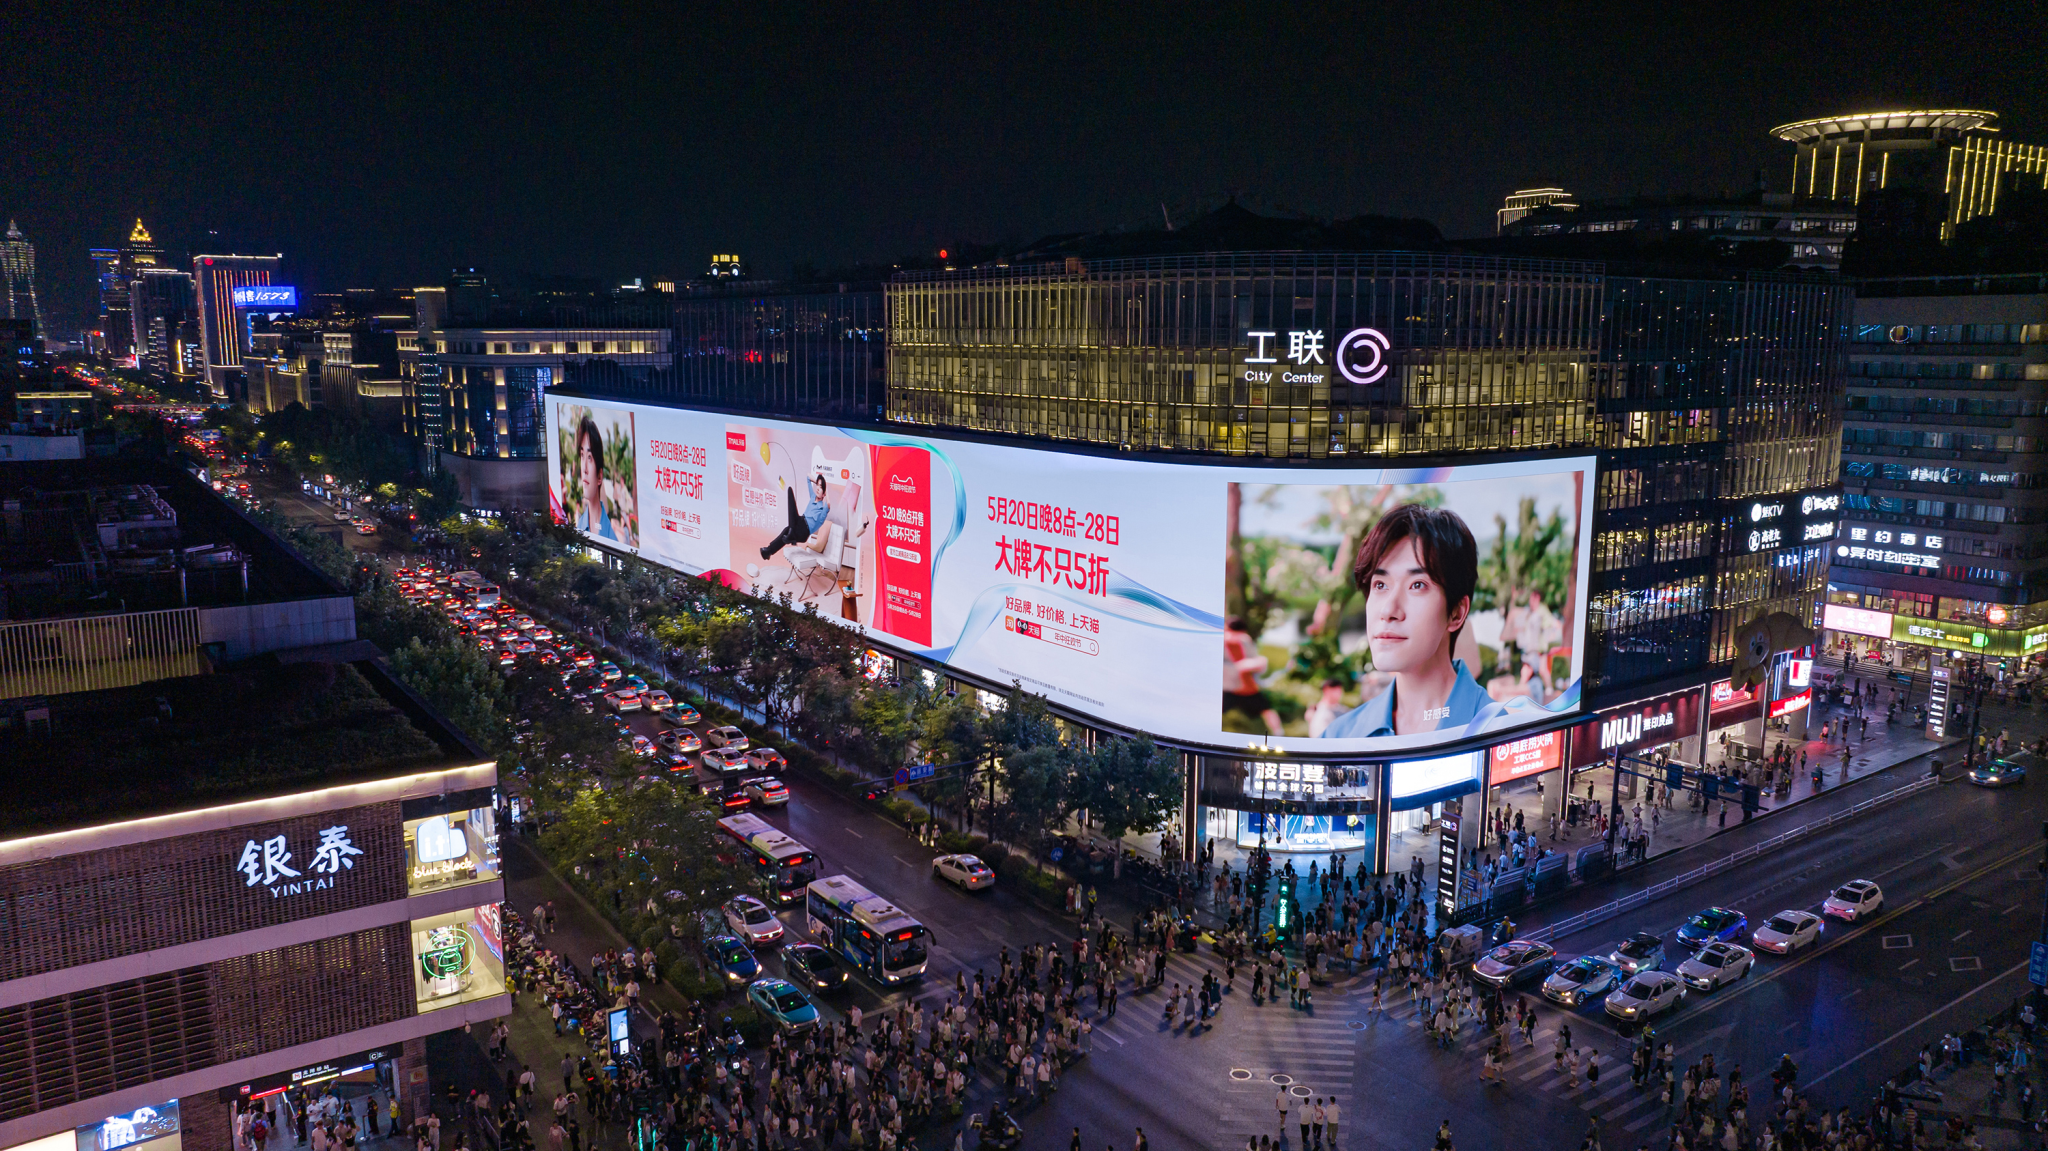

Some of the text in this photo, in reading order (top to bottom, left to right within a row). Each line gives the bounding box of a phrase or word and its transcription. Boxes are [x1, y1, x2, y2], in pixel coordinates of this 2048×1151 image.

[1244, 329, 1325, 365] 工联
[1244, 370, 1325, 384] City Center
[650, 440, 706, 467] 5月20日晚8点-28日
[655, 465, 703, 500] 大牌不只5折
[882, 505, 896, 520] 5.20
[988, 496, 1119, 546] 5月20日晚8点-28日
[886, 523, 921, 545] 大牌不只5折
[1851, 527, 1943, 549] 里约酒店
[994, 535, 1110, 598] 大牌不只5折
[1908, 625, 1945, 640] 德克士
[1422, 706, 1450, 721] 好感受
[1601, 712, 1674, 750] MUJI 無印良品
[1254, 762, 1325, 783] 波司登
[236, 825, 364, 887] 银泰
[413, 857, 475, 879] blue block
[270, 876, 334, 898] YINTAI
